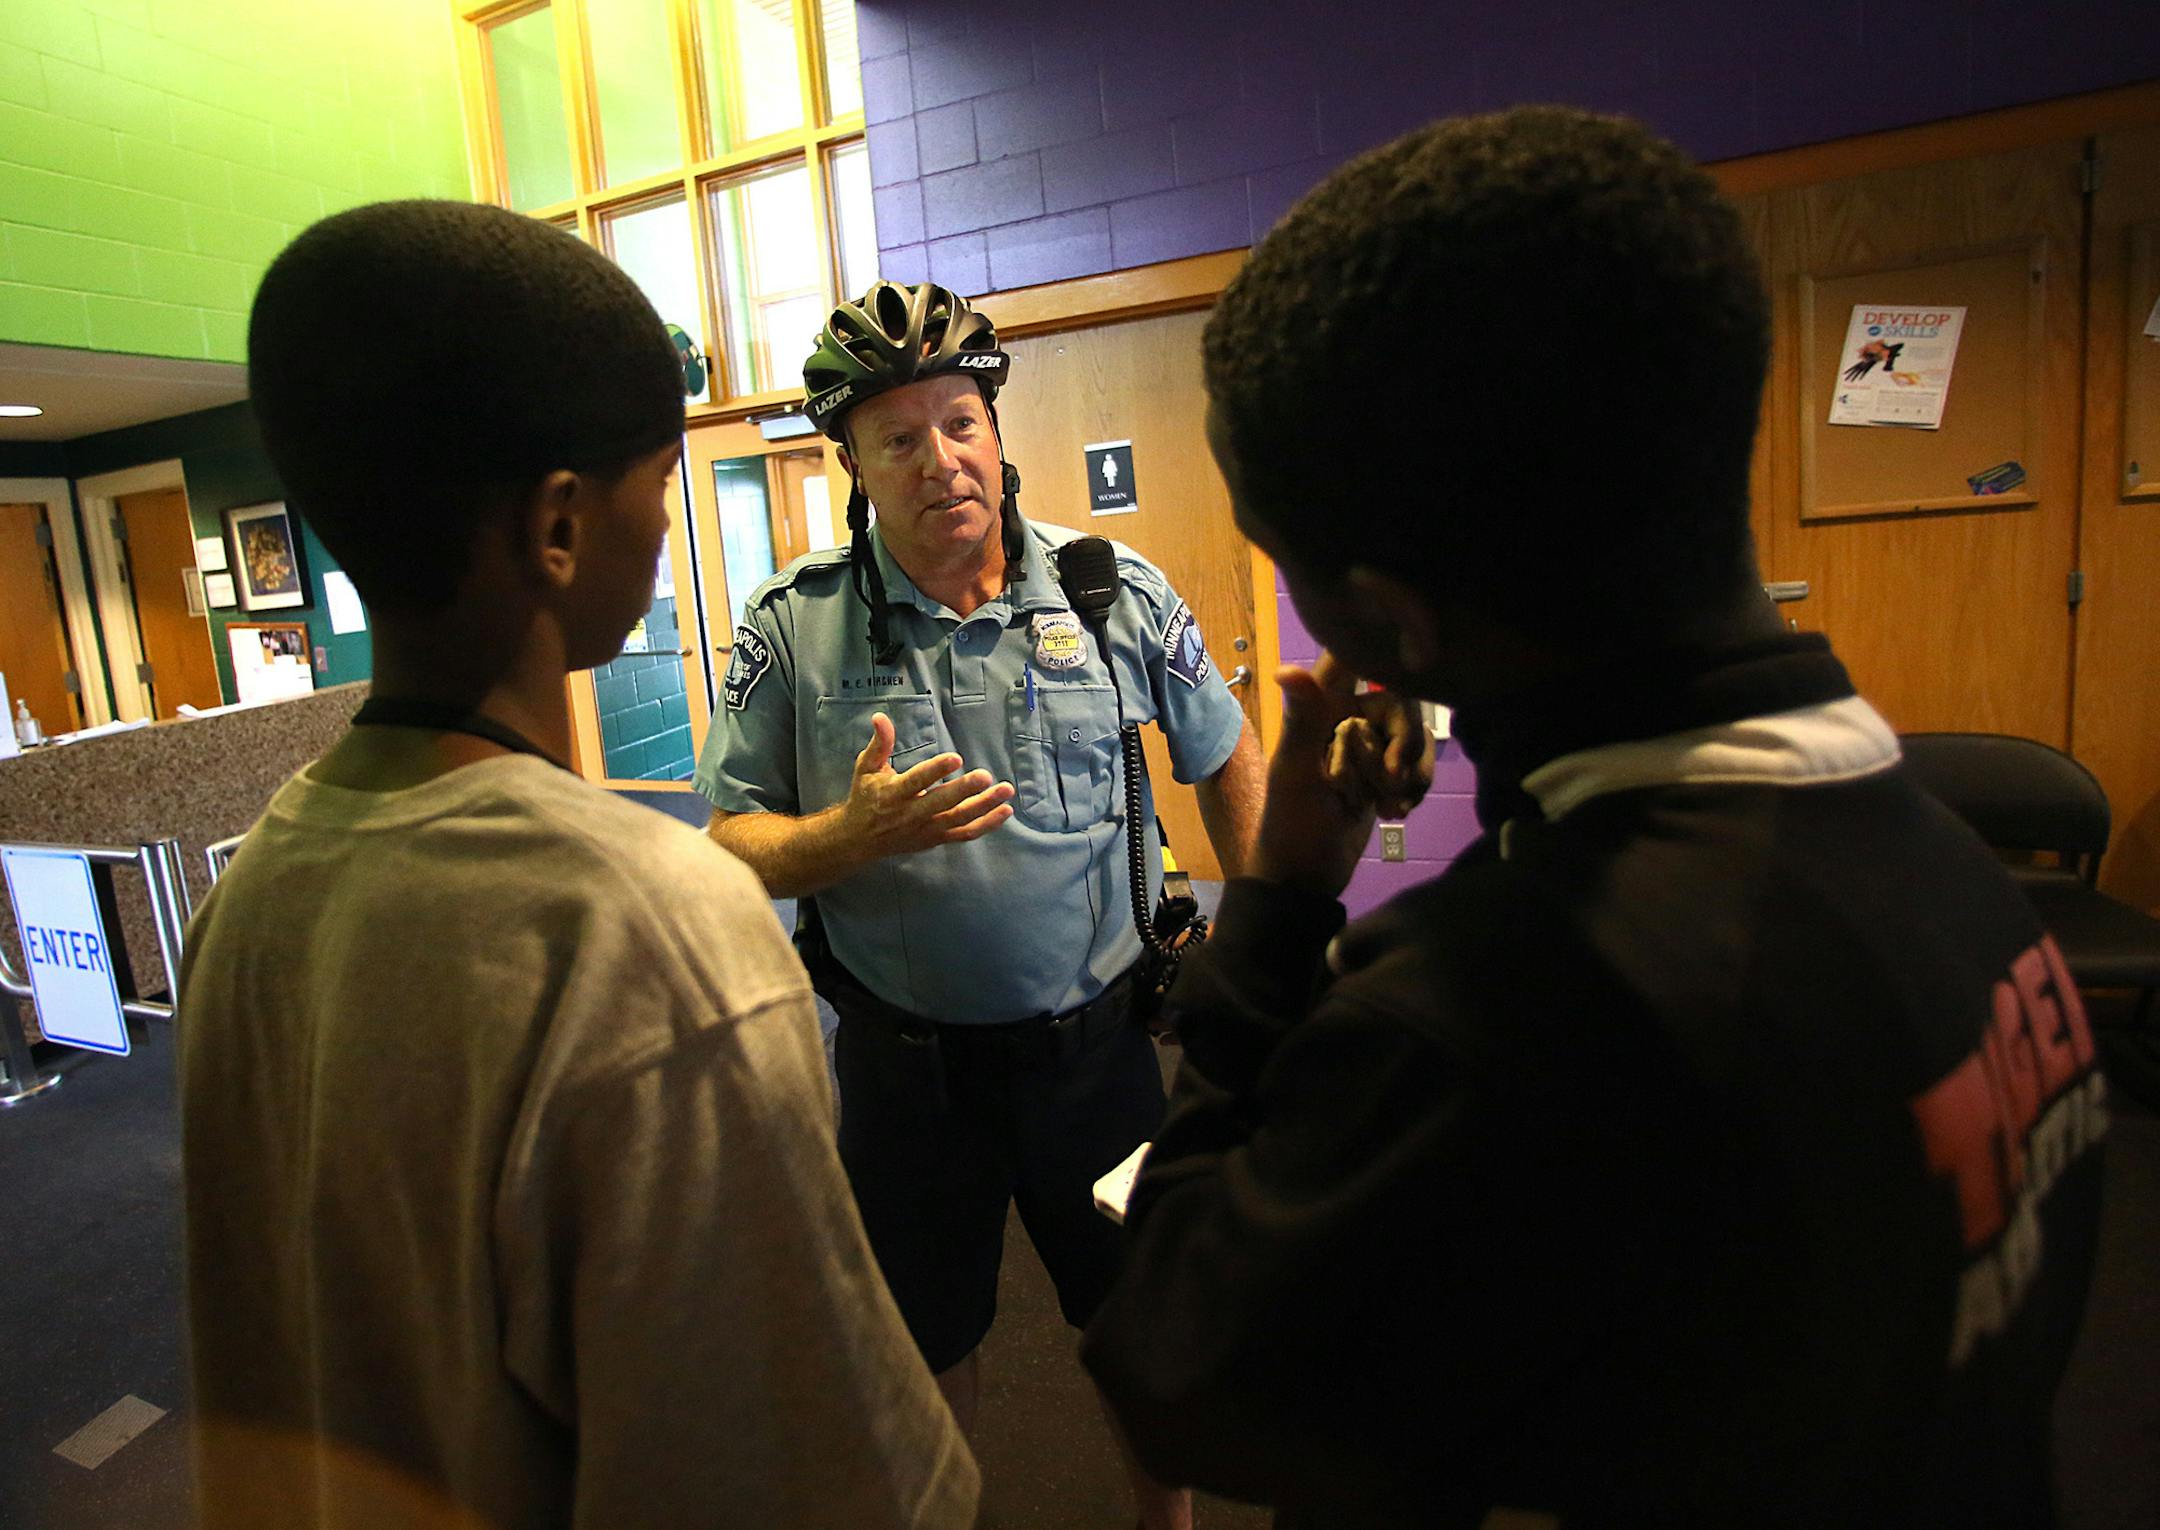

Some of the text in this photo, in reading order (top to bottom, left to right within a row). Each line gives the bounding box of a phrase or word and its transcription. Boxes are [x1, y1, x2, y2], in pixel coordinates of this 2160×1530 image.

[1863, 312, 1950, 326] DEVELOP
[1884, 326, 1939, 338] SKILLS
[958, 355, 1002, 369] LAZER
[815, 385, 854, 416] LAZER
[1097, 492, 1127, 502] WOMEN
[1047, 655, 1080, 666] POLICE
[26, 926, 105, 972] ENTER
